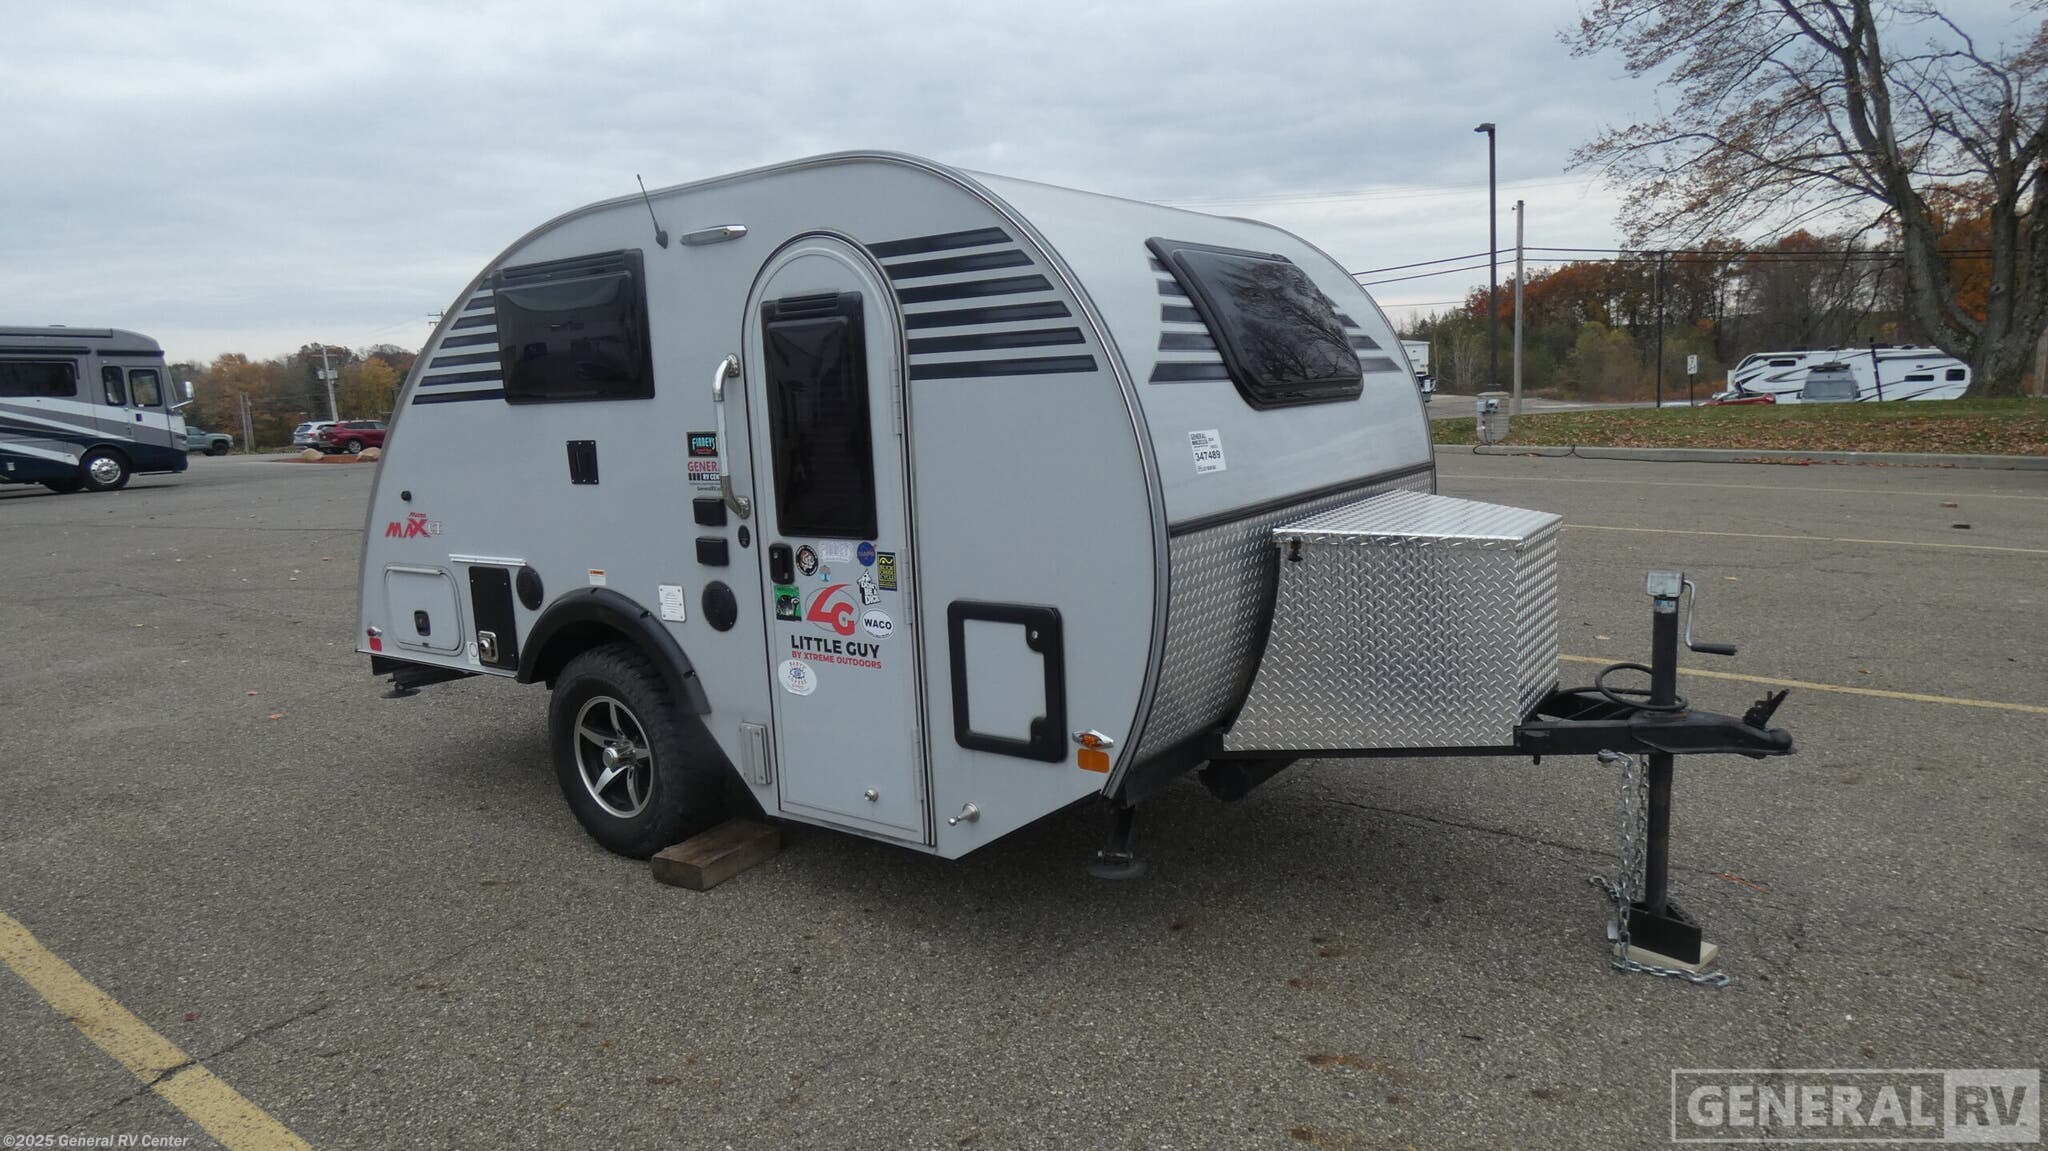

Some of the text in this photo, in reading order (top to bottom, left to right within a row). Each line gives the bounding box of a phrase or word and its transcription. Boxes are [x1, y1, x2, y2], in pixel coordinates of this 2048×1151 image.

[1195, 450, 1220, 461] 347489
[688, 461, 719, 472] GENER
[385, 518, 430, 538] MAX
[864, 618, 892, 630] WACO
[791, 634, 880, 659] LITTLE GUY
[792, 650, 882, 669] BY XTREME OUTDOORS
